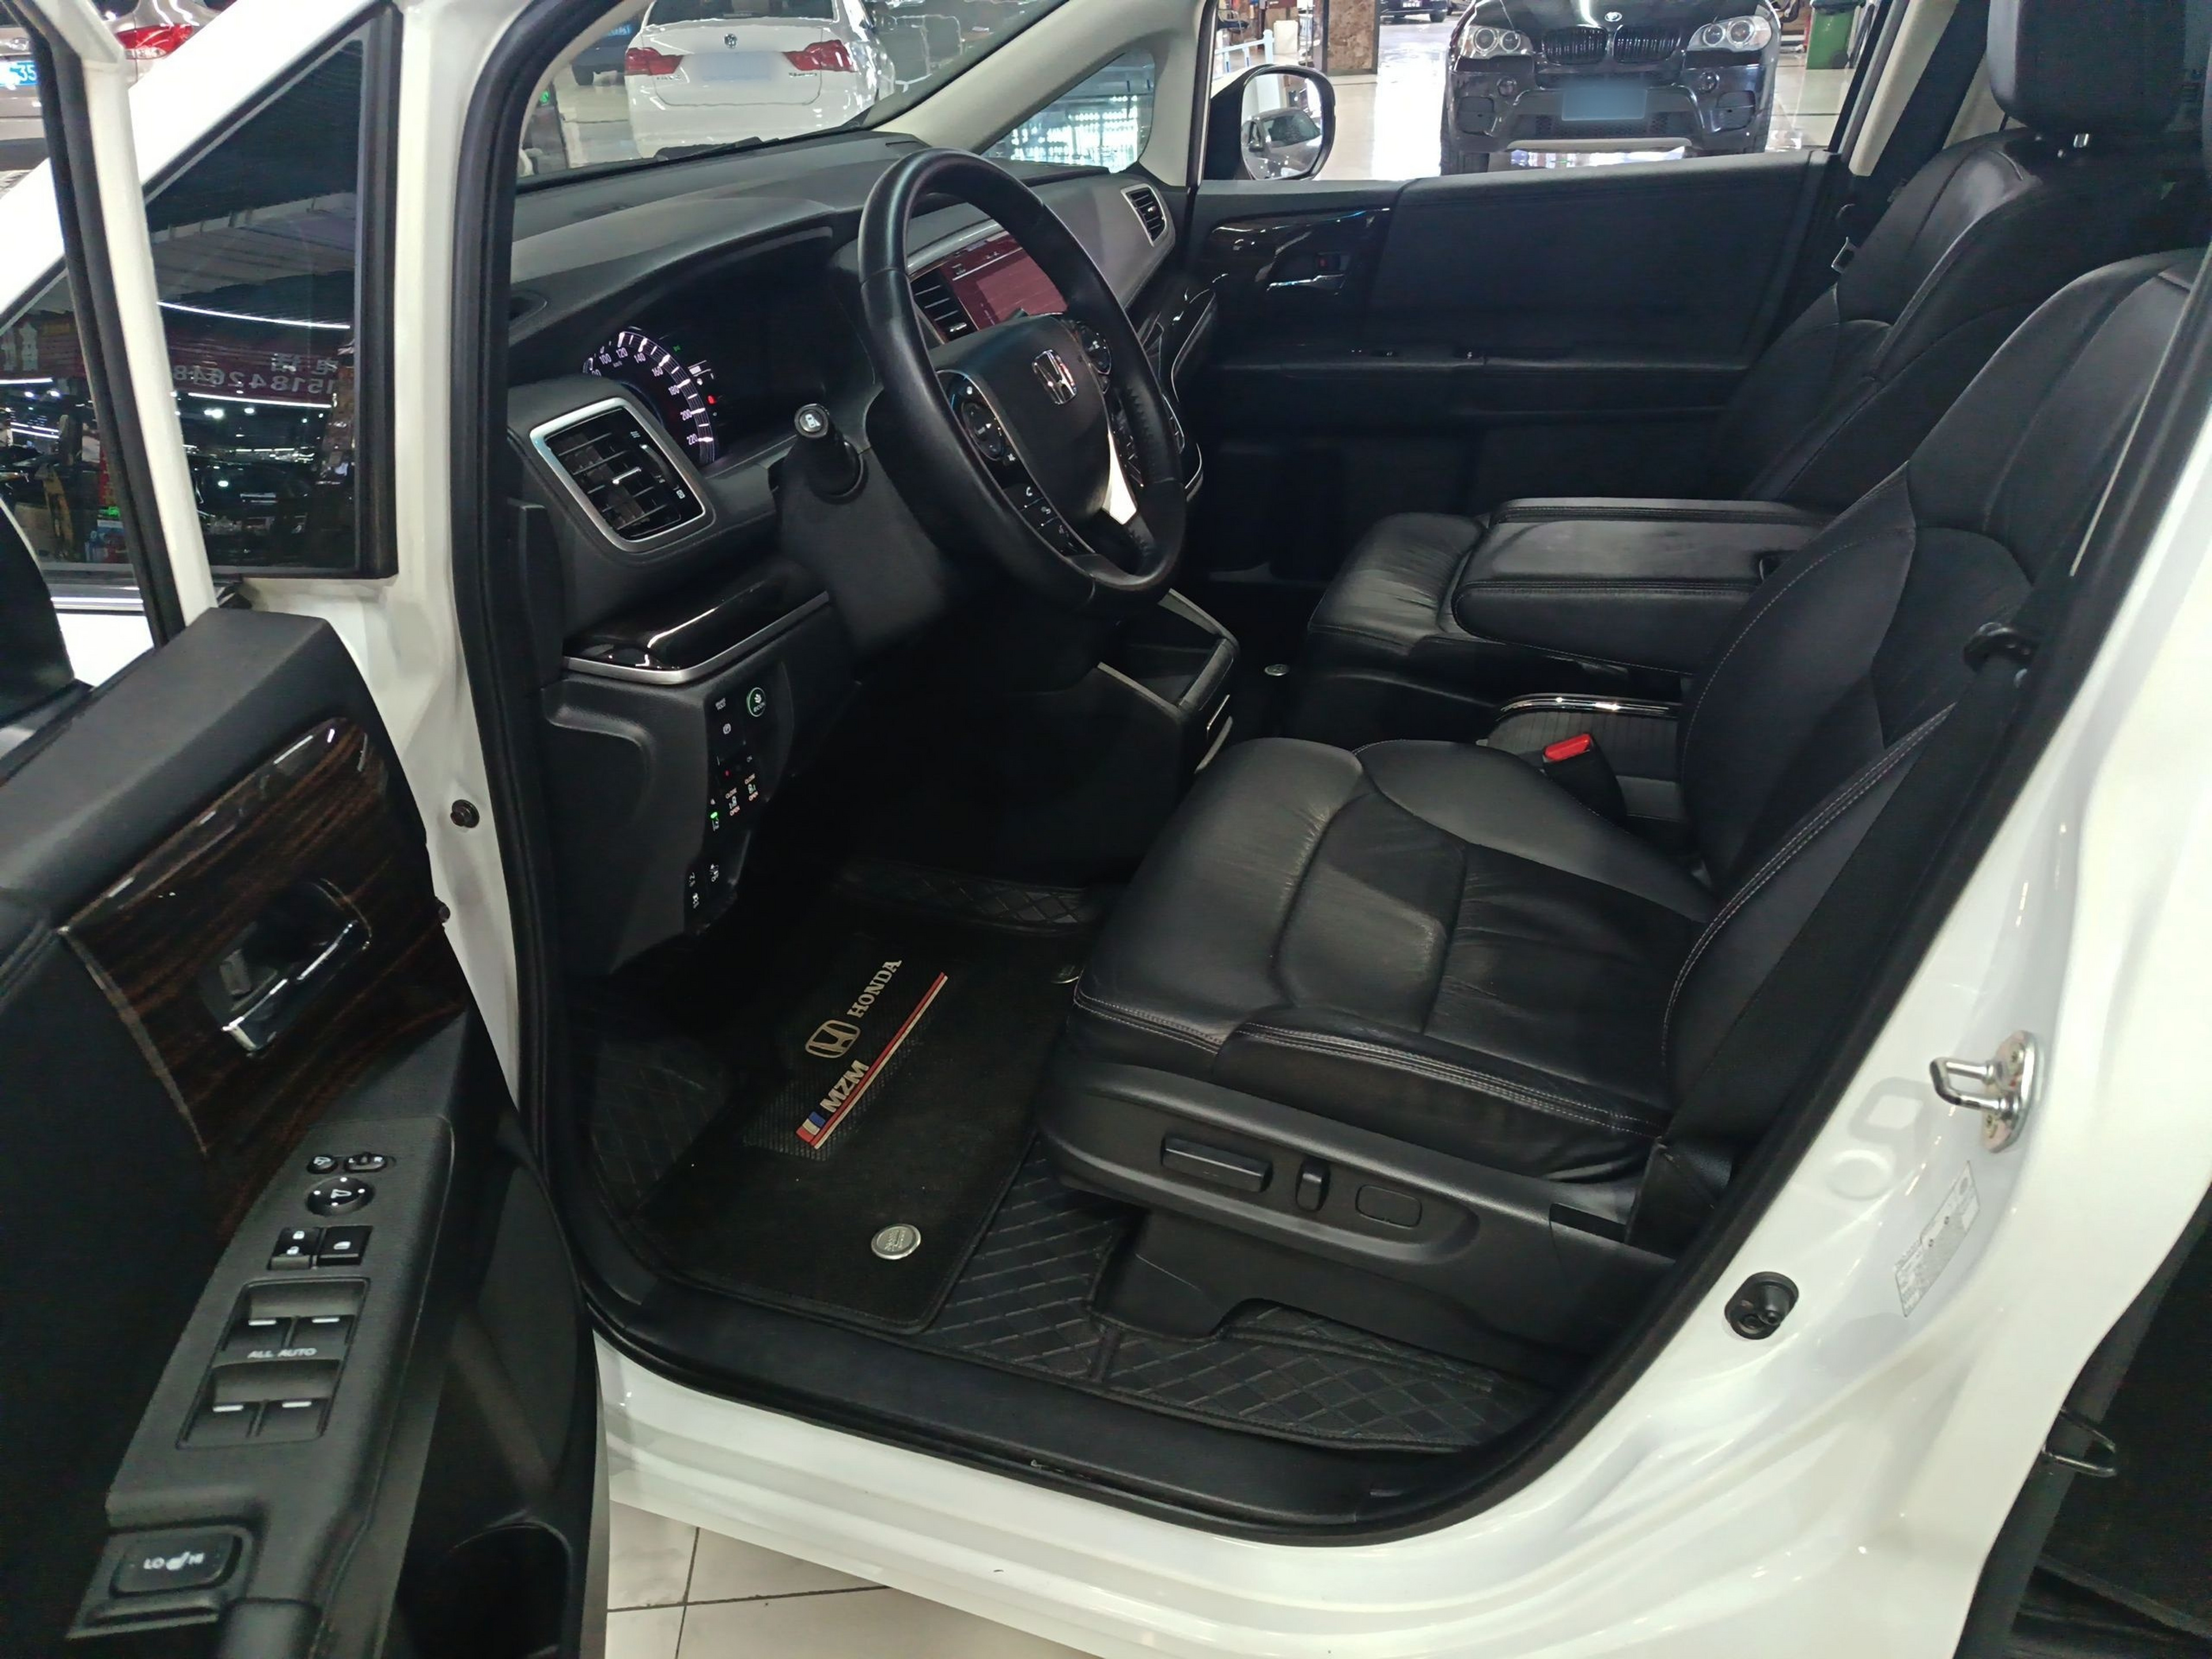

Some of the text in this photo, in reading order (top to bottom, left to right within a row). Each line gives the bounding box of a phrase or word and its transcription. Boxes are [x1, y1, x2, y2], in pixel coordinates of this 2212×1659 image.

[616, 347, 628, 358] 120
[634, 353, 646, 363] 140
[599, 353, 612, 365] 100
[652, 366, 664, 377] 160
[668, 385, 680, 396] 180
[680, 409, 692, 421] 200
[687, 433, 698, 445] 220
[847, 960, 903, 1018] HONDA
[820, 1059, 870, 1112] MZM
[247, 1347, 317, 1358] ALL AUTO
